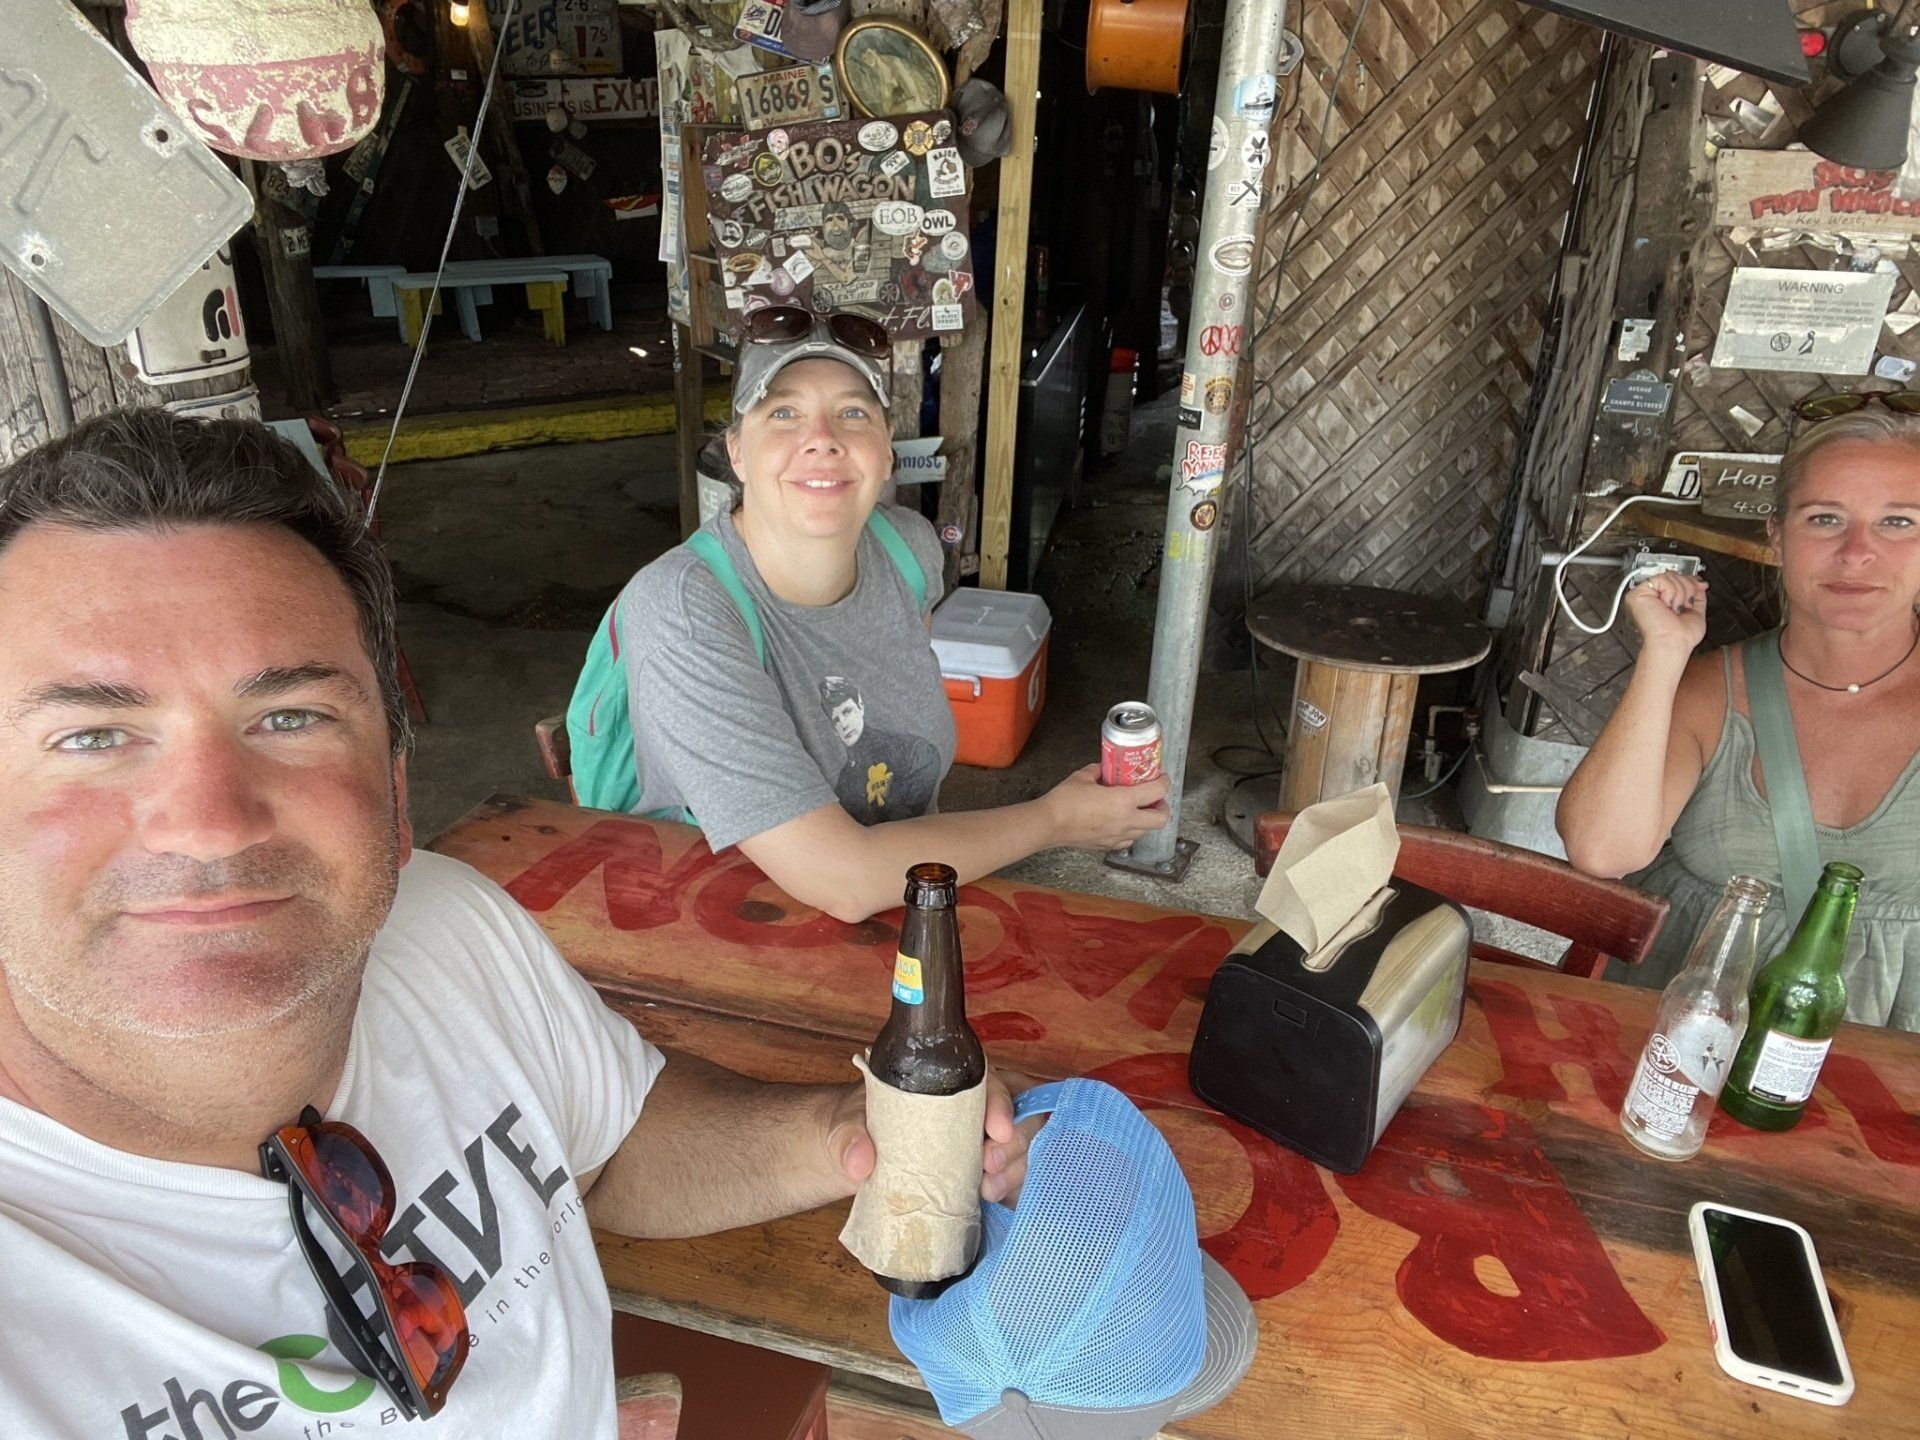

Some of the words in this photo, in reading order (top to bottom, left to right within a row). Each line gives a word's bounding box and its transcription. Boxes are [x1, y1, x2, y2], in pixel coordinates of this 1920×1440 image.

[763, 68, 807, 85] MAINE
[745, 79, 810, 118] 16869
[818, 74, 834, 104] S
[747, 180, 807, 223] FISH
[809, 173, 917, 204] WAGON
[879, 207, 918, 225] EOB
[922, 215, 954, 230] OWL
[1795, 215, 1819, 226] Key
[1777, 280, 1845, 295] WARNING
[1717, 467, 1778, 490] Hap
[486, 1299, 511, 1325] in
[513, 1251, 552, 1290] the
